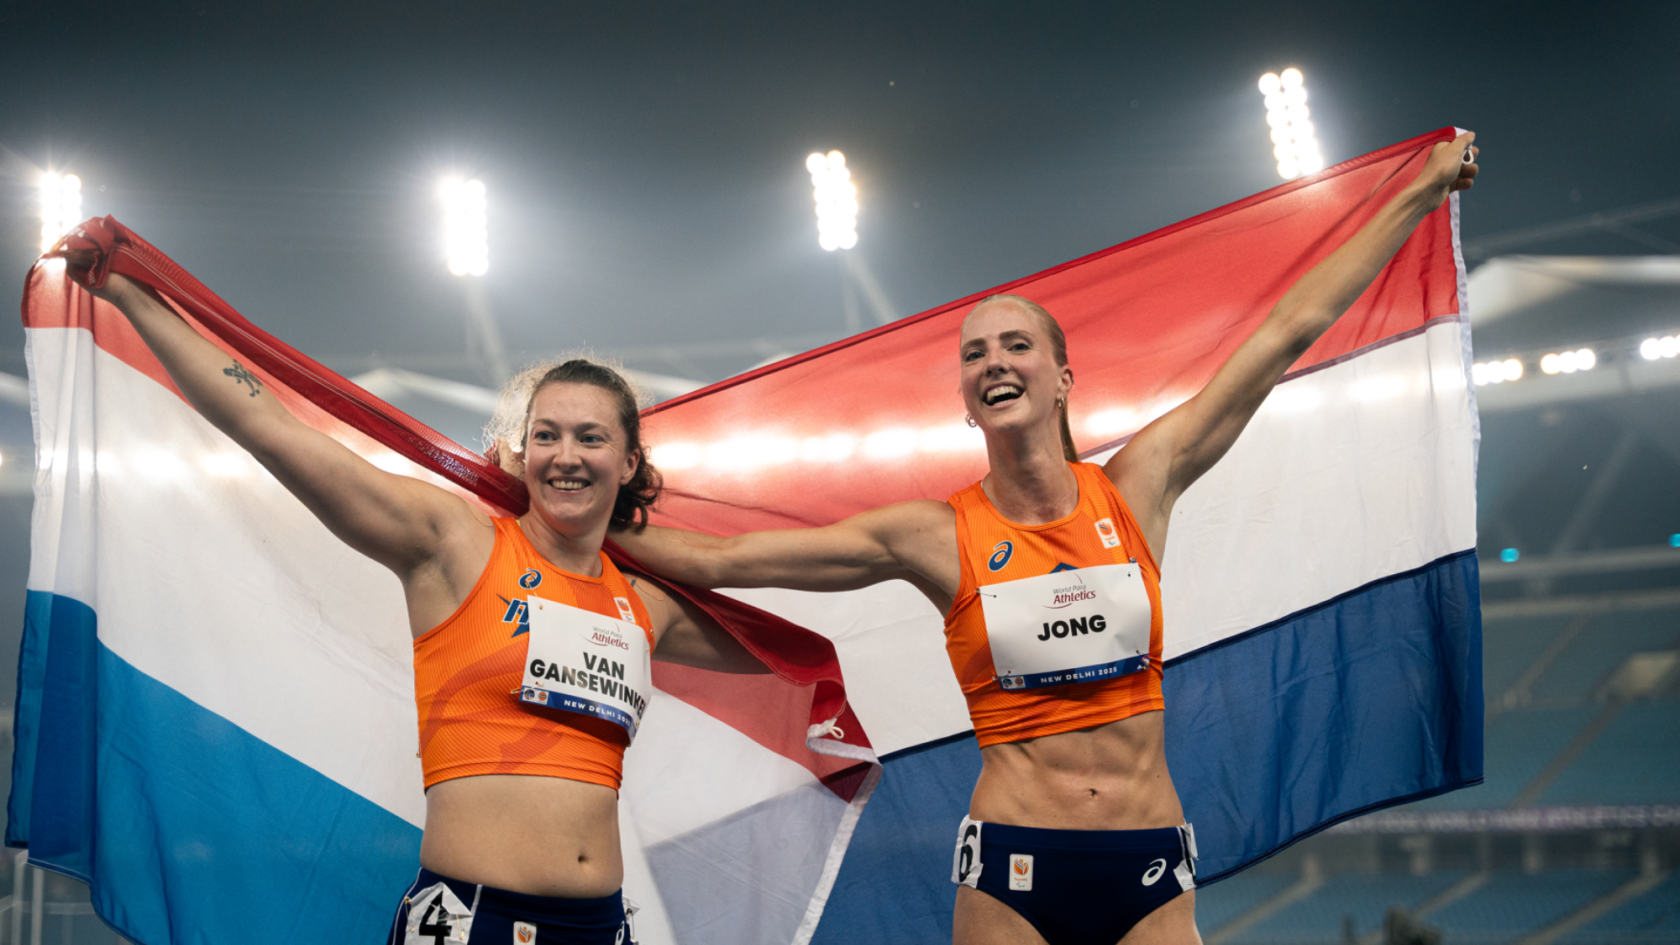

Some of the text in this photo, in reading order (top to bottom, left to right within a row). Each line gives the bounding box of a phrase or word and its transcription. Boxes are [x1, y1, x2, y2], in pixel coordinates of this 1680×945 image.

[1053, 584, 1086, 595] World Para
[1053, 590, 1096, 605] Athletics
[592, 626, 623, 639] World Para
[1037, 614, 1107, 641] JONG
[591, 632, 629, 650] Athletics
[583, 651, 625, 681] VAN
[1040, 666, 1118, 684] NEW DELHI 2025
[530, 659, 646, 720] GANSEWINKE
[564, 700, 586, 710] NEW
[589, 705, 615, 717] DELHI
[959, 824, 978, 882] 6
[418, 890, 453, 945] 4
